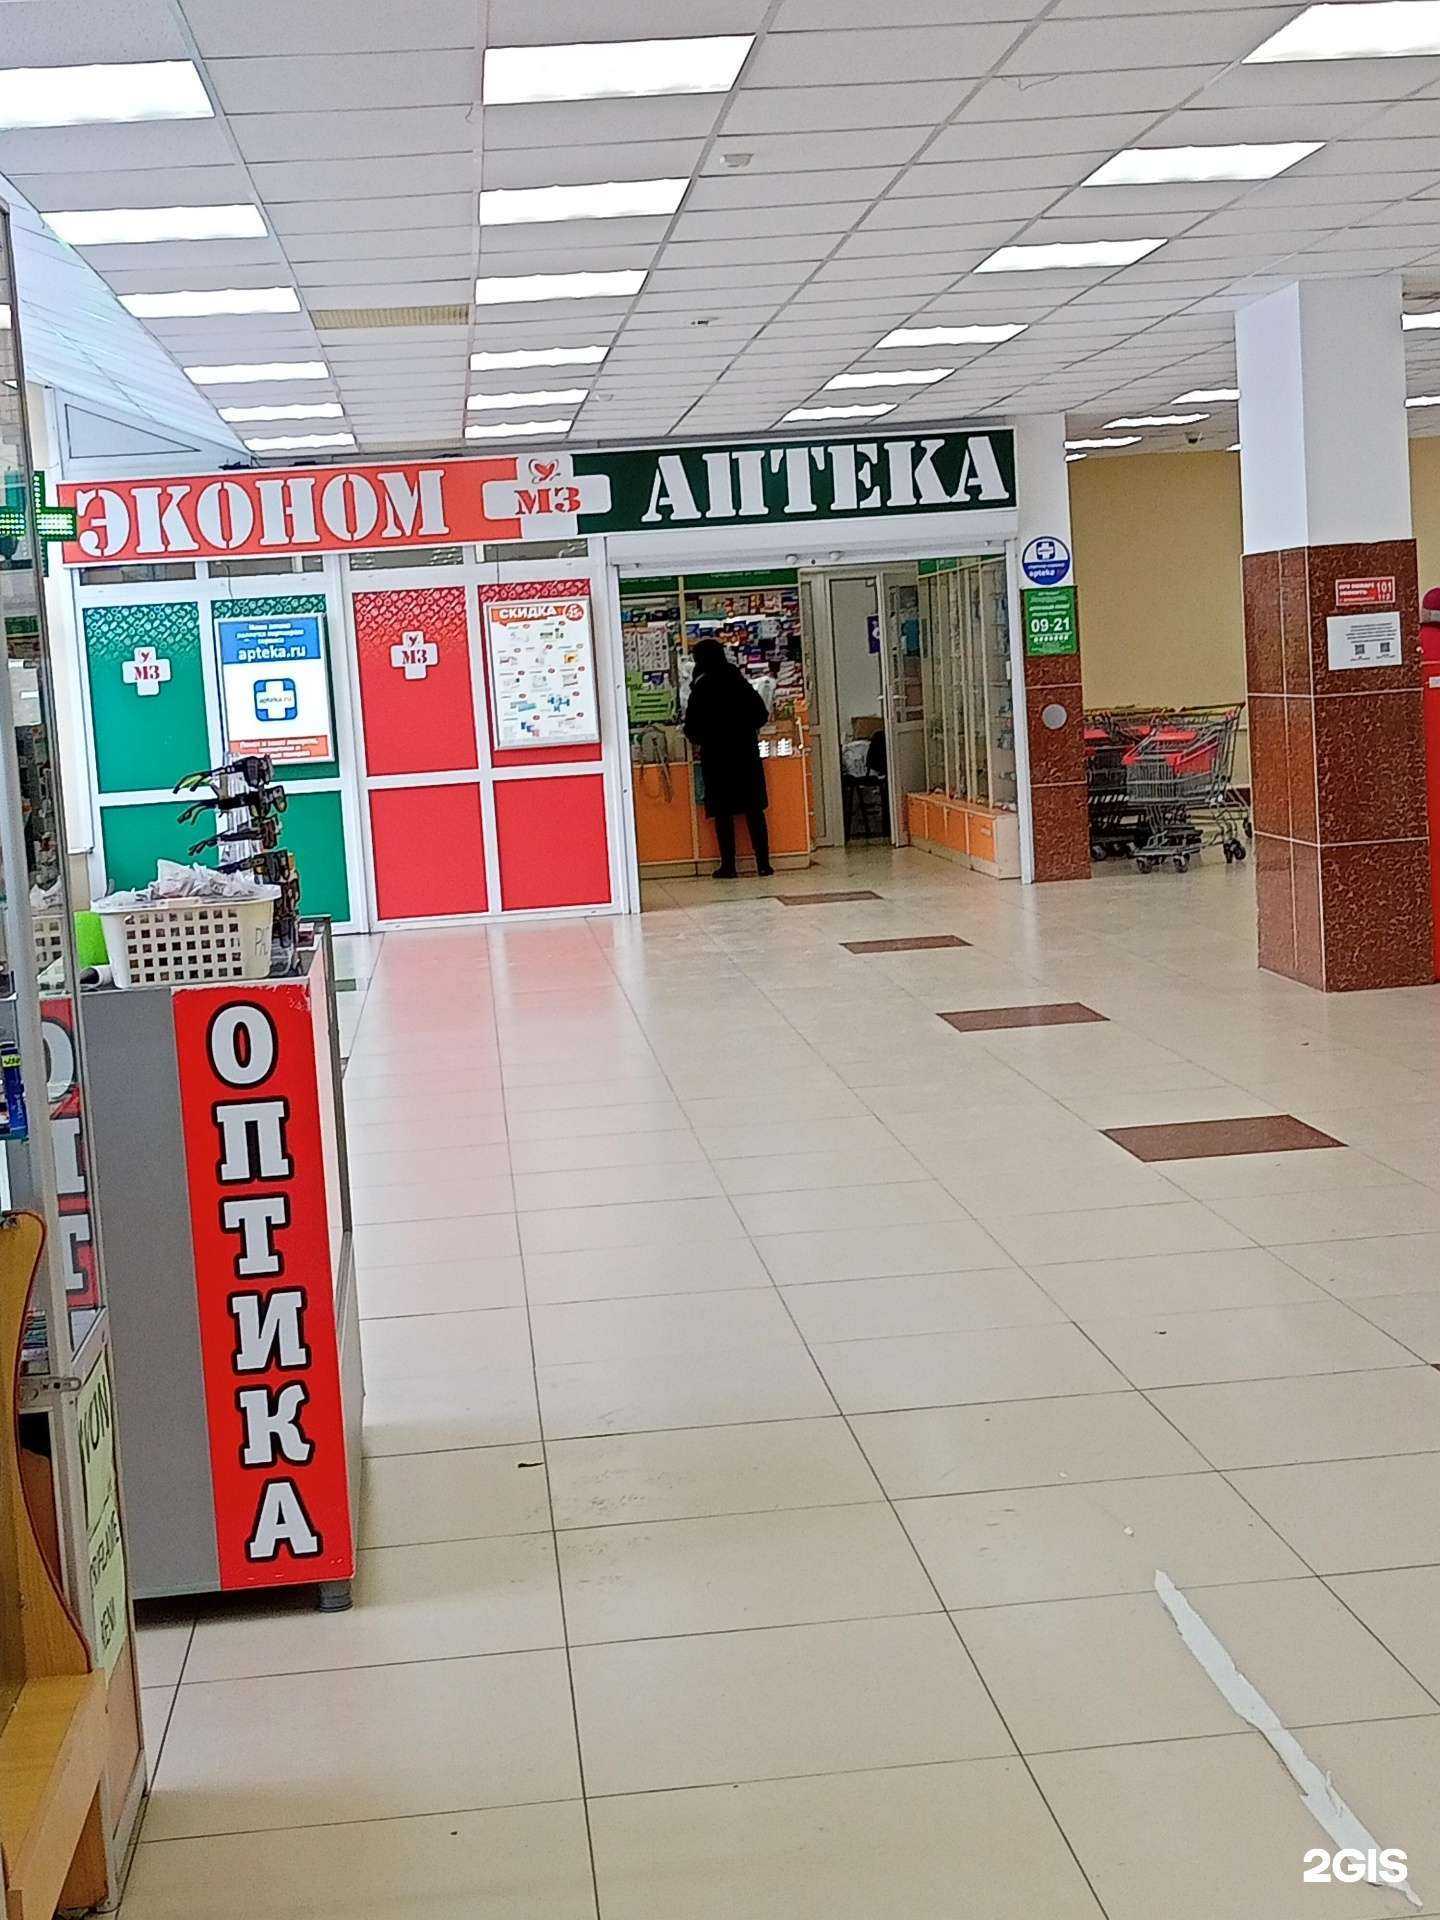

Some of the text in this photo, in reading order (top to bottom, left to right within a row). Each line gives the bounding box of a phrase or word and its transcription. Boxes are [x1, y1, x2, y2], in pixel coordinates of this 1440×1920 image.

[77, 468, 452, 557] ЭКОНОМ
[641, 435, 1010, 522] АПТЕКА
[499, 605, 558, 619] СКИДКА
[1030, 616, 1071, 633] 09-21
[238, 646, 306, 662] apteka.ru
[210, 1004, 321, 1560] ОПТИКА
